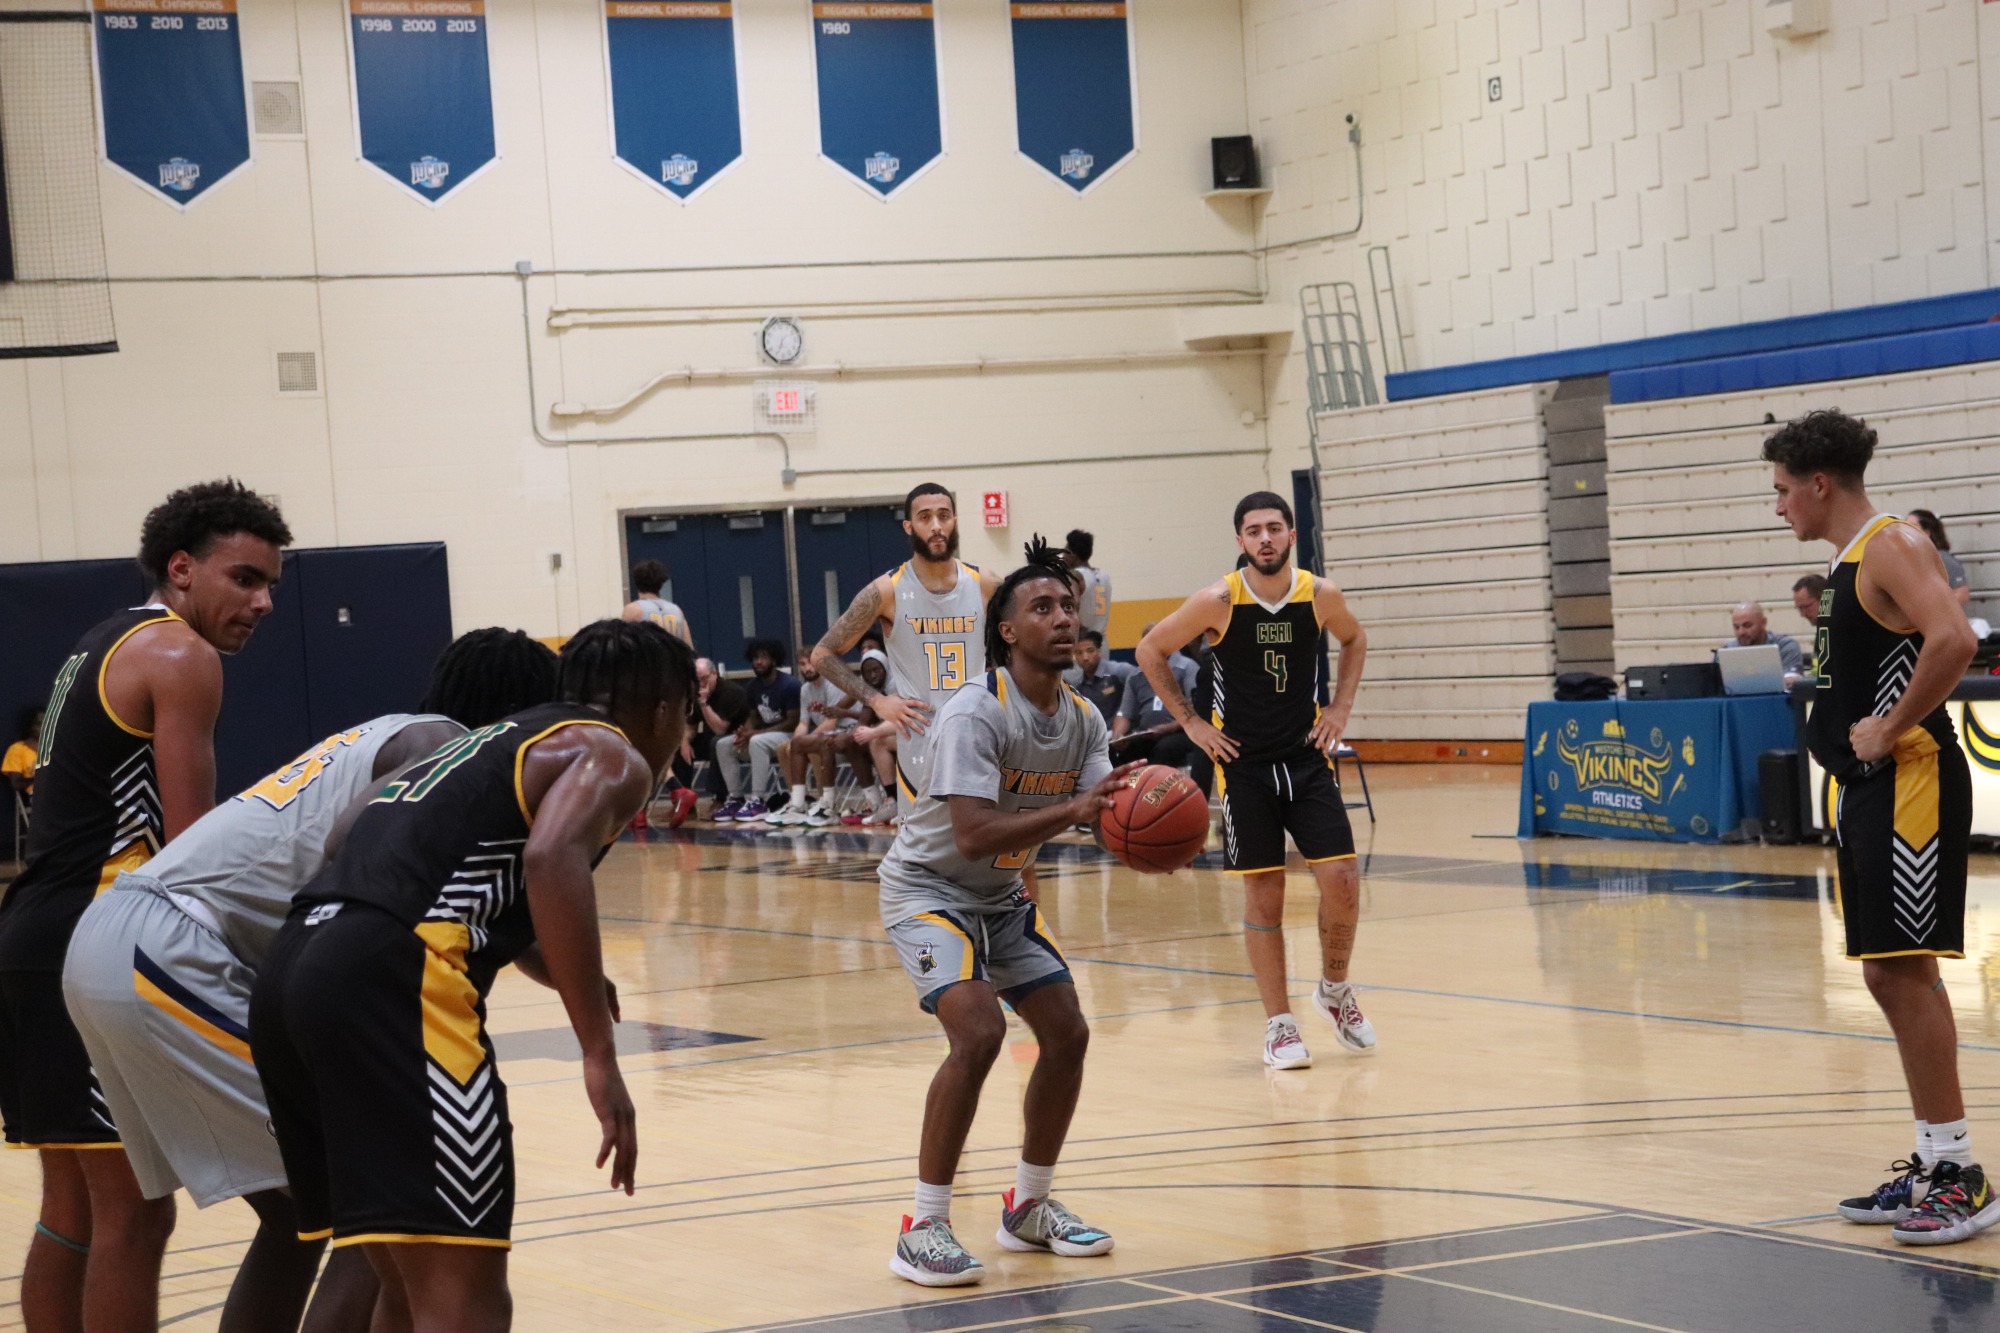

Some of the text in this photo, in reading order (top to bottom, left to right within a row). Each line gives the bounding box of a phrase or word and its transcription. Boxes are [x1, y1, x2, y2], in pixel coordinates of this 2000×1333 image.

[104, 15, 229, 30] 1983 2010 2013
[360, 18, 477, 33] 1998 2000 2013
[822, 22, 850, 34] 1980
[776, 390, 799, 411] EXIT
[905, 612, 977, 635] VIKINGS
[1256, 622, 1293, 644] CCRI
[923, 641, 967, 690] 13
[1264, 650, 1288, 692] 4
[1000, 761, 1081, 796] VIKINGS
[1559, 743, 1671, 798] VIKINGS
[1592, 789, 1643, 811] ATHLETICS
